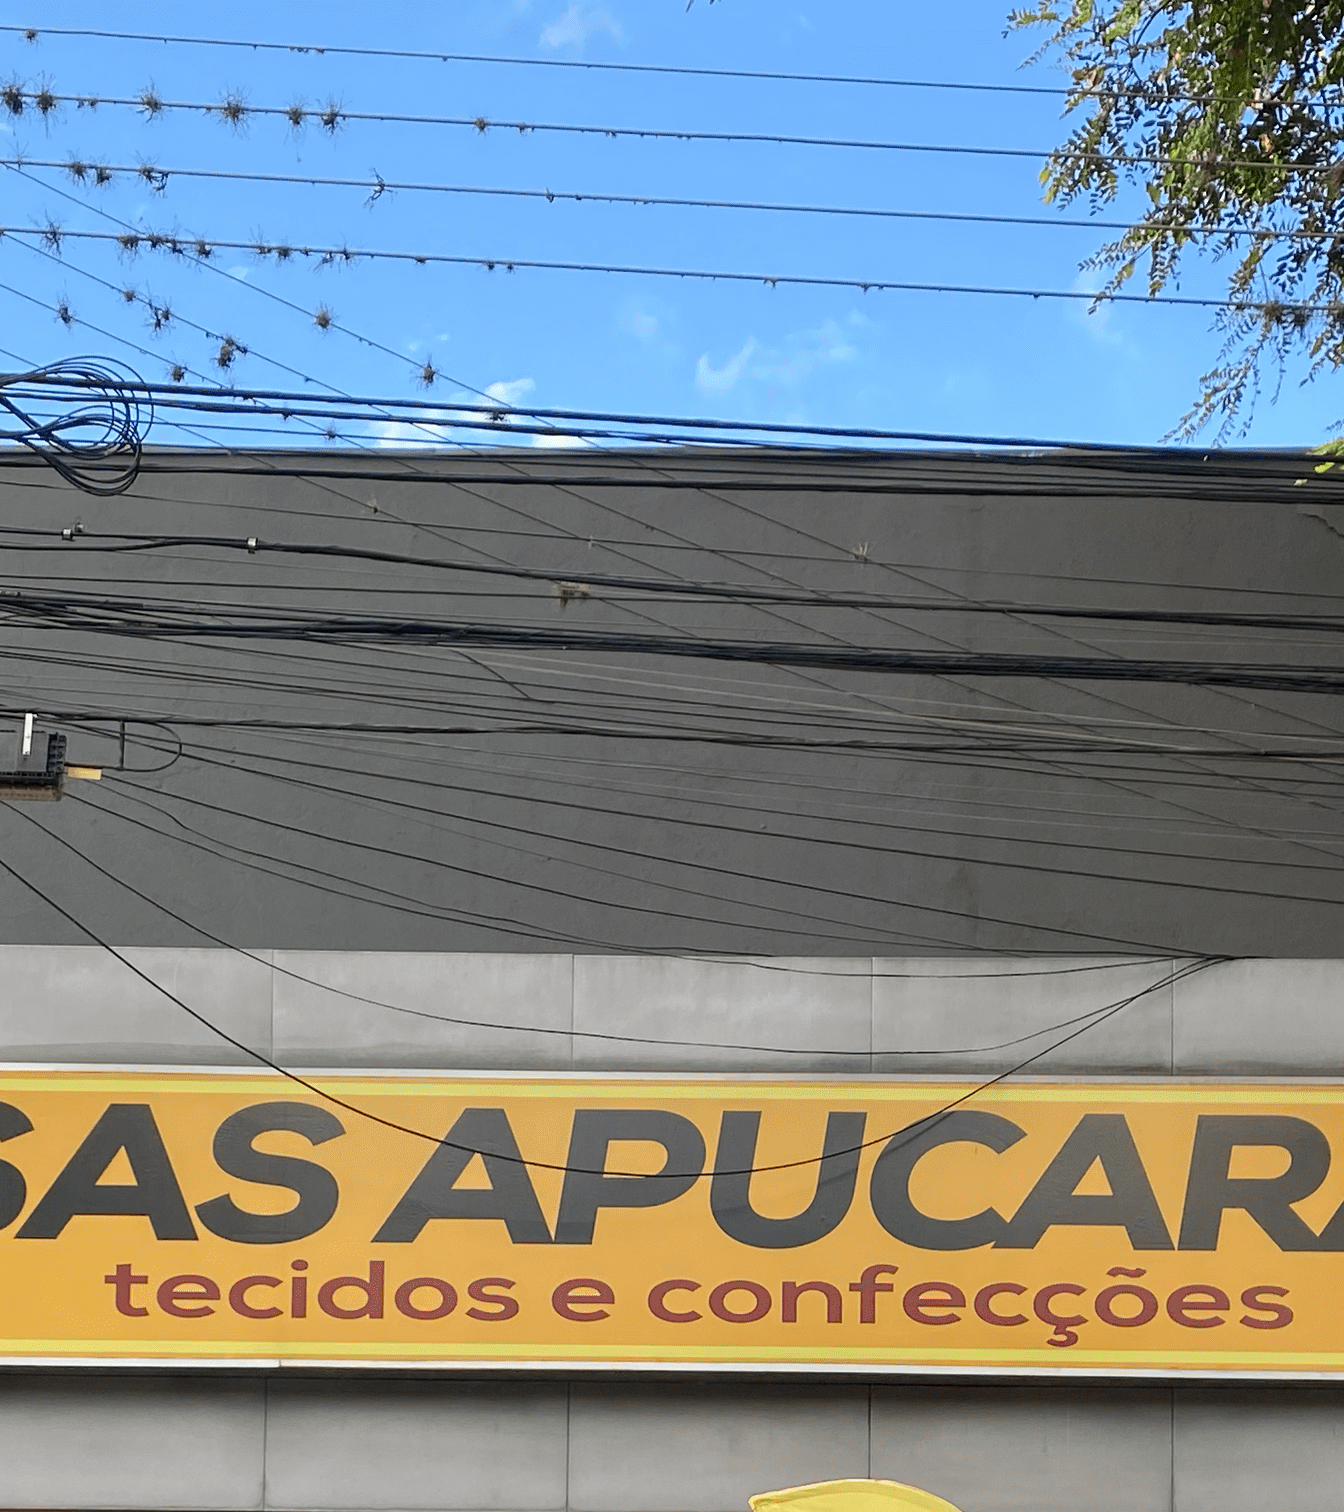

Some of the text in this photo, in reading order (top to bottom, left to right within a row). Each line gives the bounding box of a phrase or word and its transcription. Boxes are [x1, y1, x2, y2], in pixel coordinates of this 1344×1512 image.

[105, 1259, 1294, 1348] tecidos e confecções
